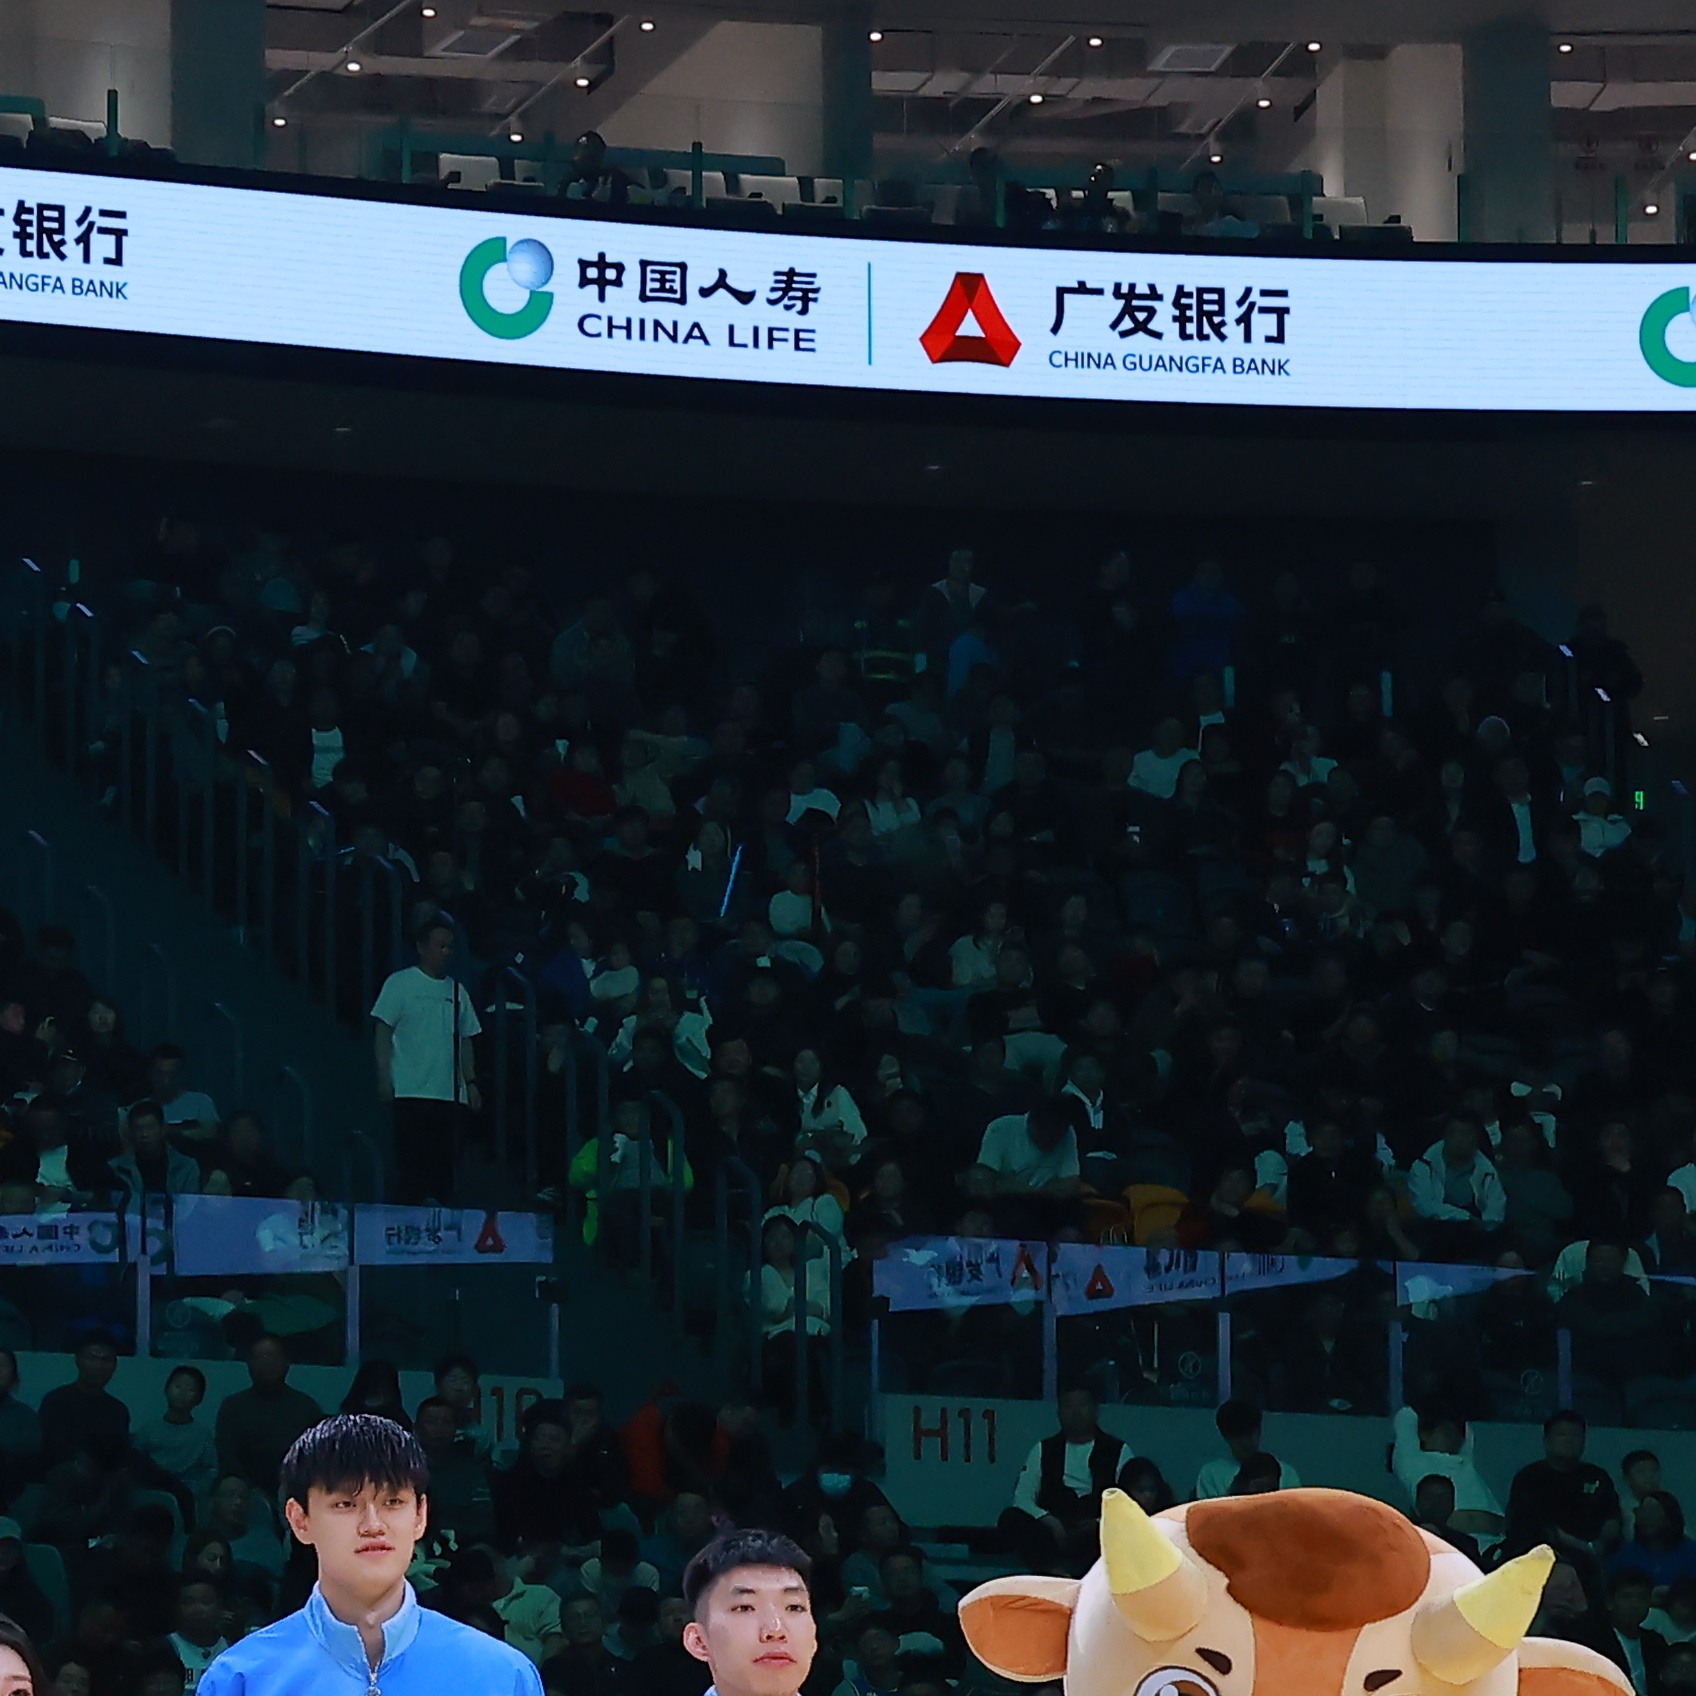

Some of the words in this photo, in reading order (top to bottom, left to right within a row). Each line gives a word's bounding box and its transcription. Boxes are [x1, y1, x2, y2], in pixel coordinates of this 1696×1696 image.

[71, 277, 129, 301] BANK
[576, 250, 822, 317] 中国人寿
[577, 312, 712, 347] CHINA
[727, 323, 817, 354] LIFE
[1049, 279, 1291, 345] 广发银行
[1048, 349, 1117, 371] CHINA
[1122, 352, 1227, 375] GUANGFA
[1232, 356, 1291, 377] BANK
[912, 1406, 996, 1463] H11
